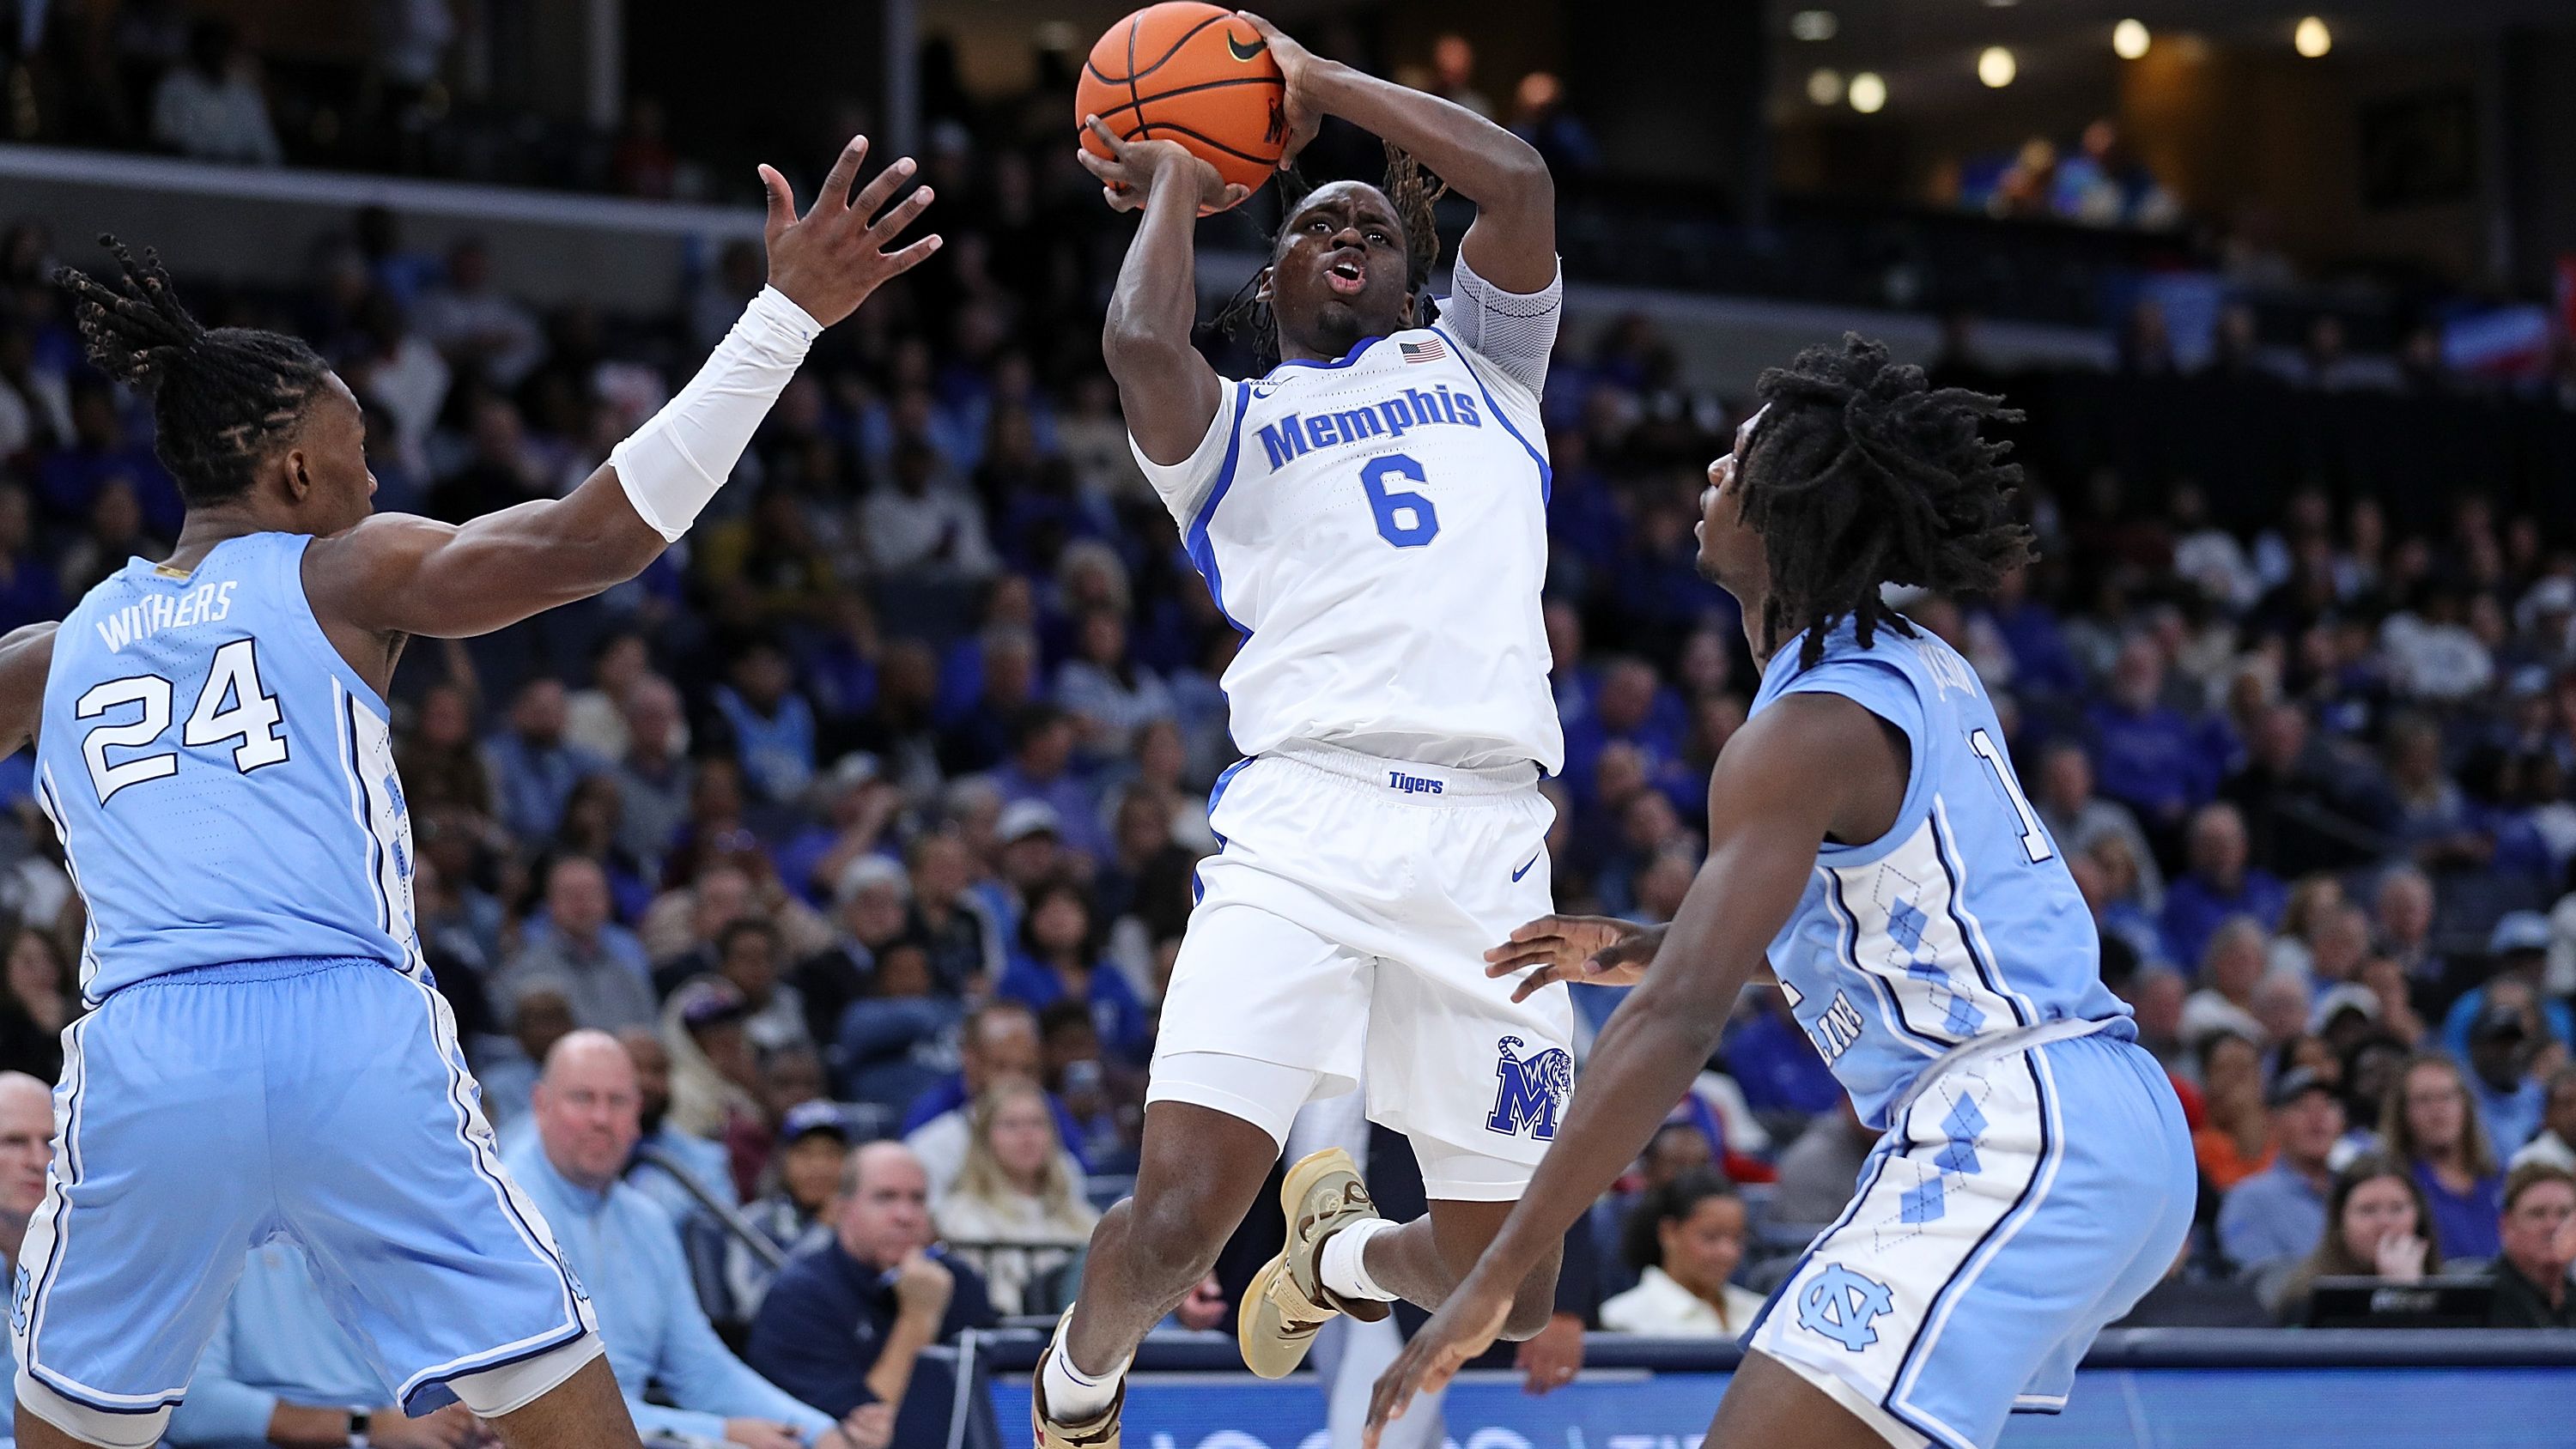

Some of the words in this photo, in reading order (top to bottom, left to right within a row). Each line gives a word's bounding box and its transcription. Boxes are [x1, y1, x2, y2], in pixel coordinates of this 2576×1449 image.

[1252, 384, 1483, 475] Memphis
[1358, 452, 1441, 550] 6
[95, 580, 237, 654] WITHERS
[75, 634, 289, 809] 24
[1388, 771, 1443, 794] Tigers
[1485, 1056, 1558, 1142] M
